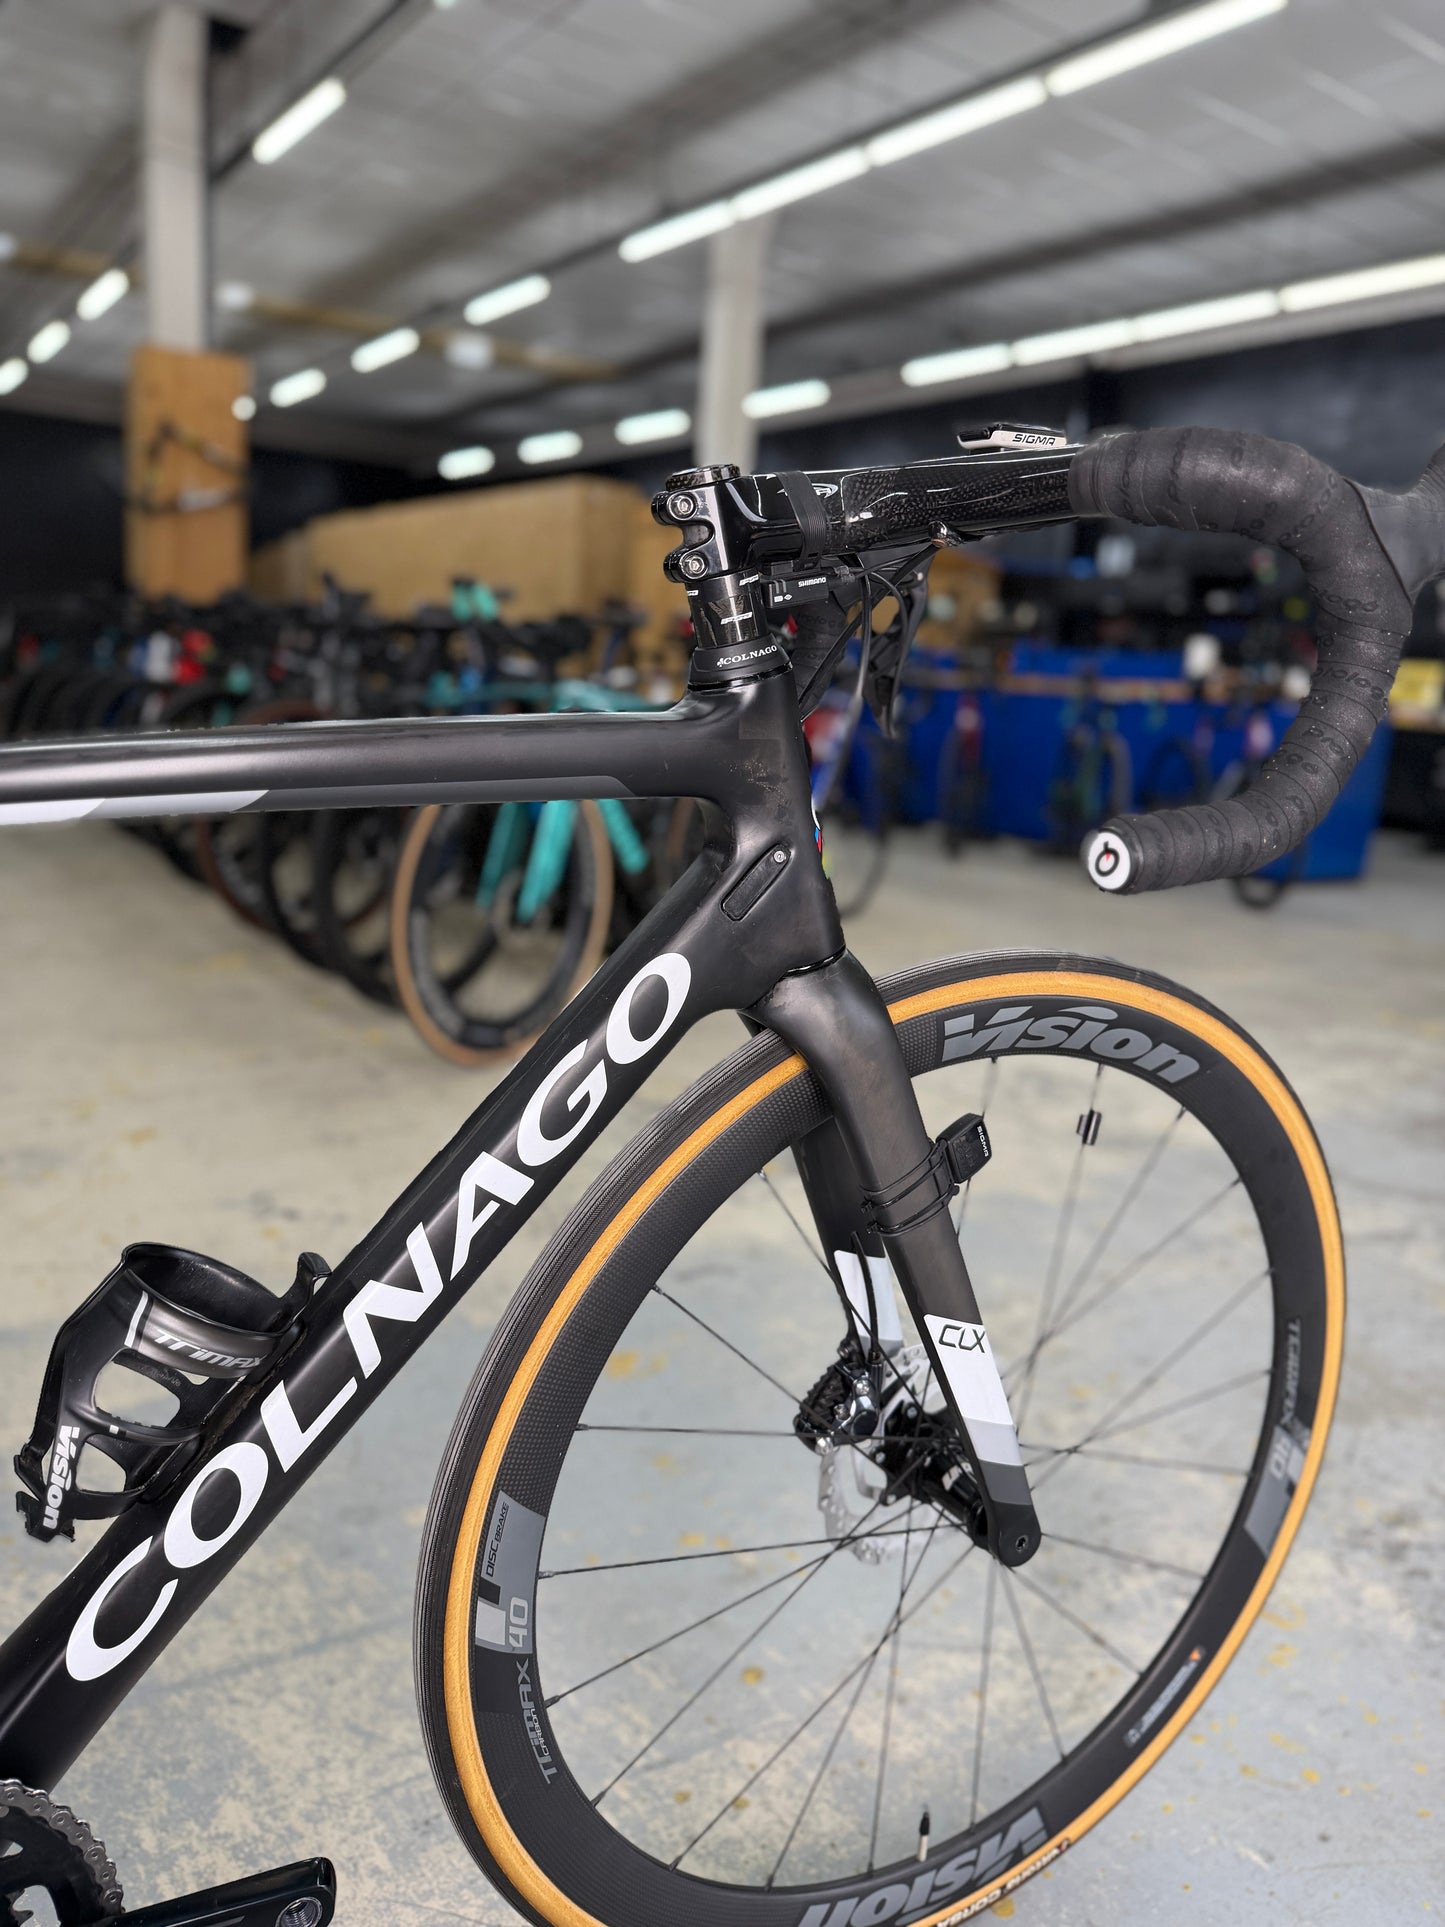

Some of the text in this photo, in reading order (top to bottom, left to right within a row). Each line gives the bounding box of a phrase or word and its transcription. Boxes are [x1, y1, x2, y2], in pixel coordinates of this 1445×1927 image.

[1012, 434, 1055, 446] SIGMA
[798, 577, 827, 588] SHIMANO
[722, 644, 778, 665] COLNAGO
[941, 1005, 1200, 1084] Vision
[976, 1125, 989, 1157] SIGMA
[66, 952, 692, 1682] COLNAGO
[939, 1323, 986, 1354] CLX
[43, 1425, 80, 1529] Vision
[486, 1501, 510, 1578] DISC BRAKE
[508, 1596, 529, 1648] 40
